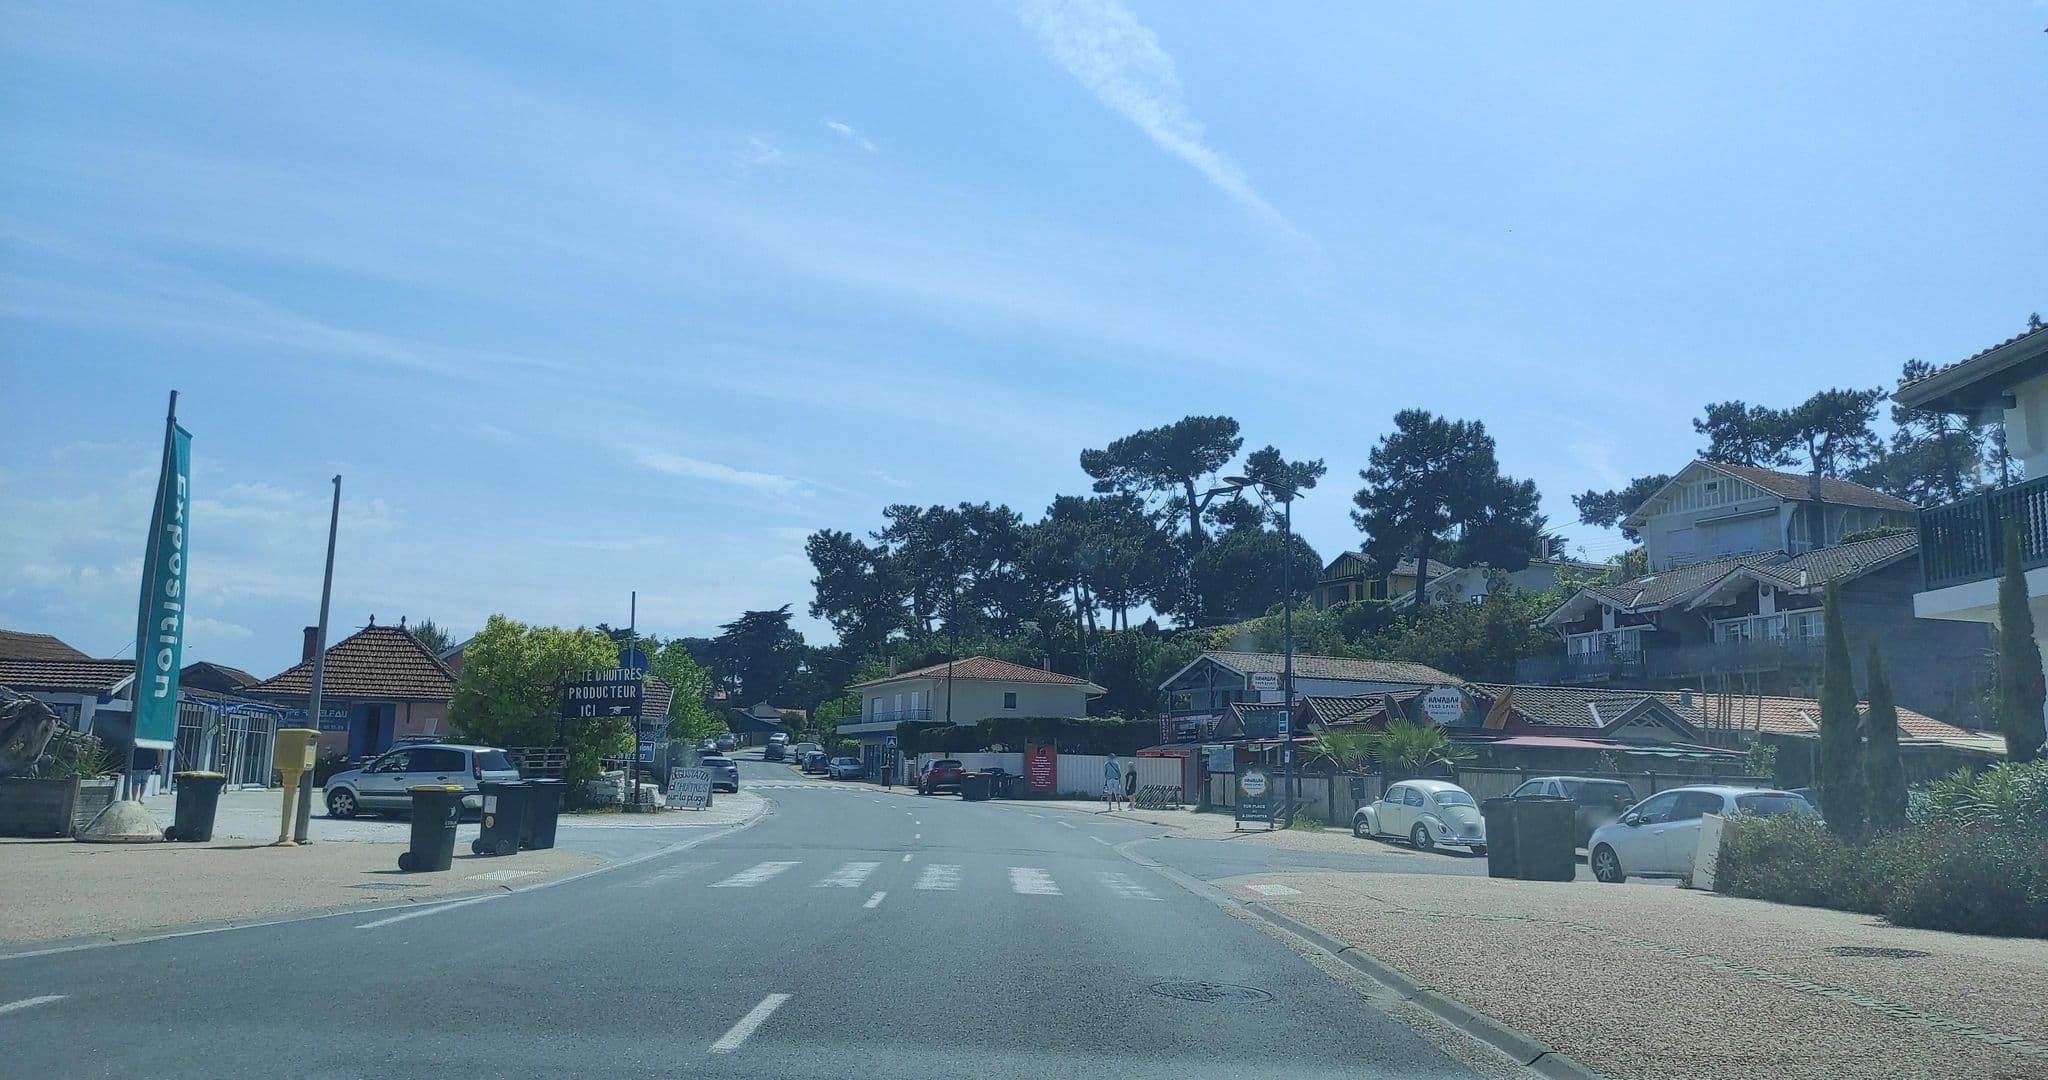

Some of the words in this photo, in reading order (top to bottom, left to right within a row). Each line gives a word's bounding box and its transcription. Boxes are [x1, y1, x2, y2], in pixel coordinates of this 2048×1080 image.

[155, 474, 187, 699] Exposition
[565, 670, 592, 682] VTE
[569, 685, 636, 700] PRODUCTEUR
[581, 704, 596, 717] ICI
